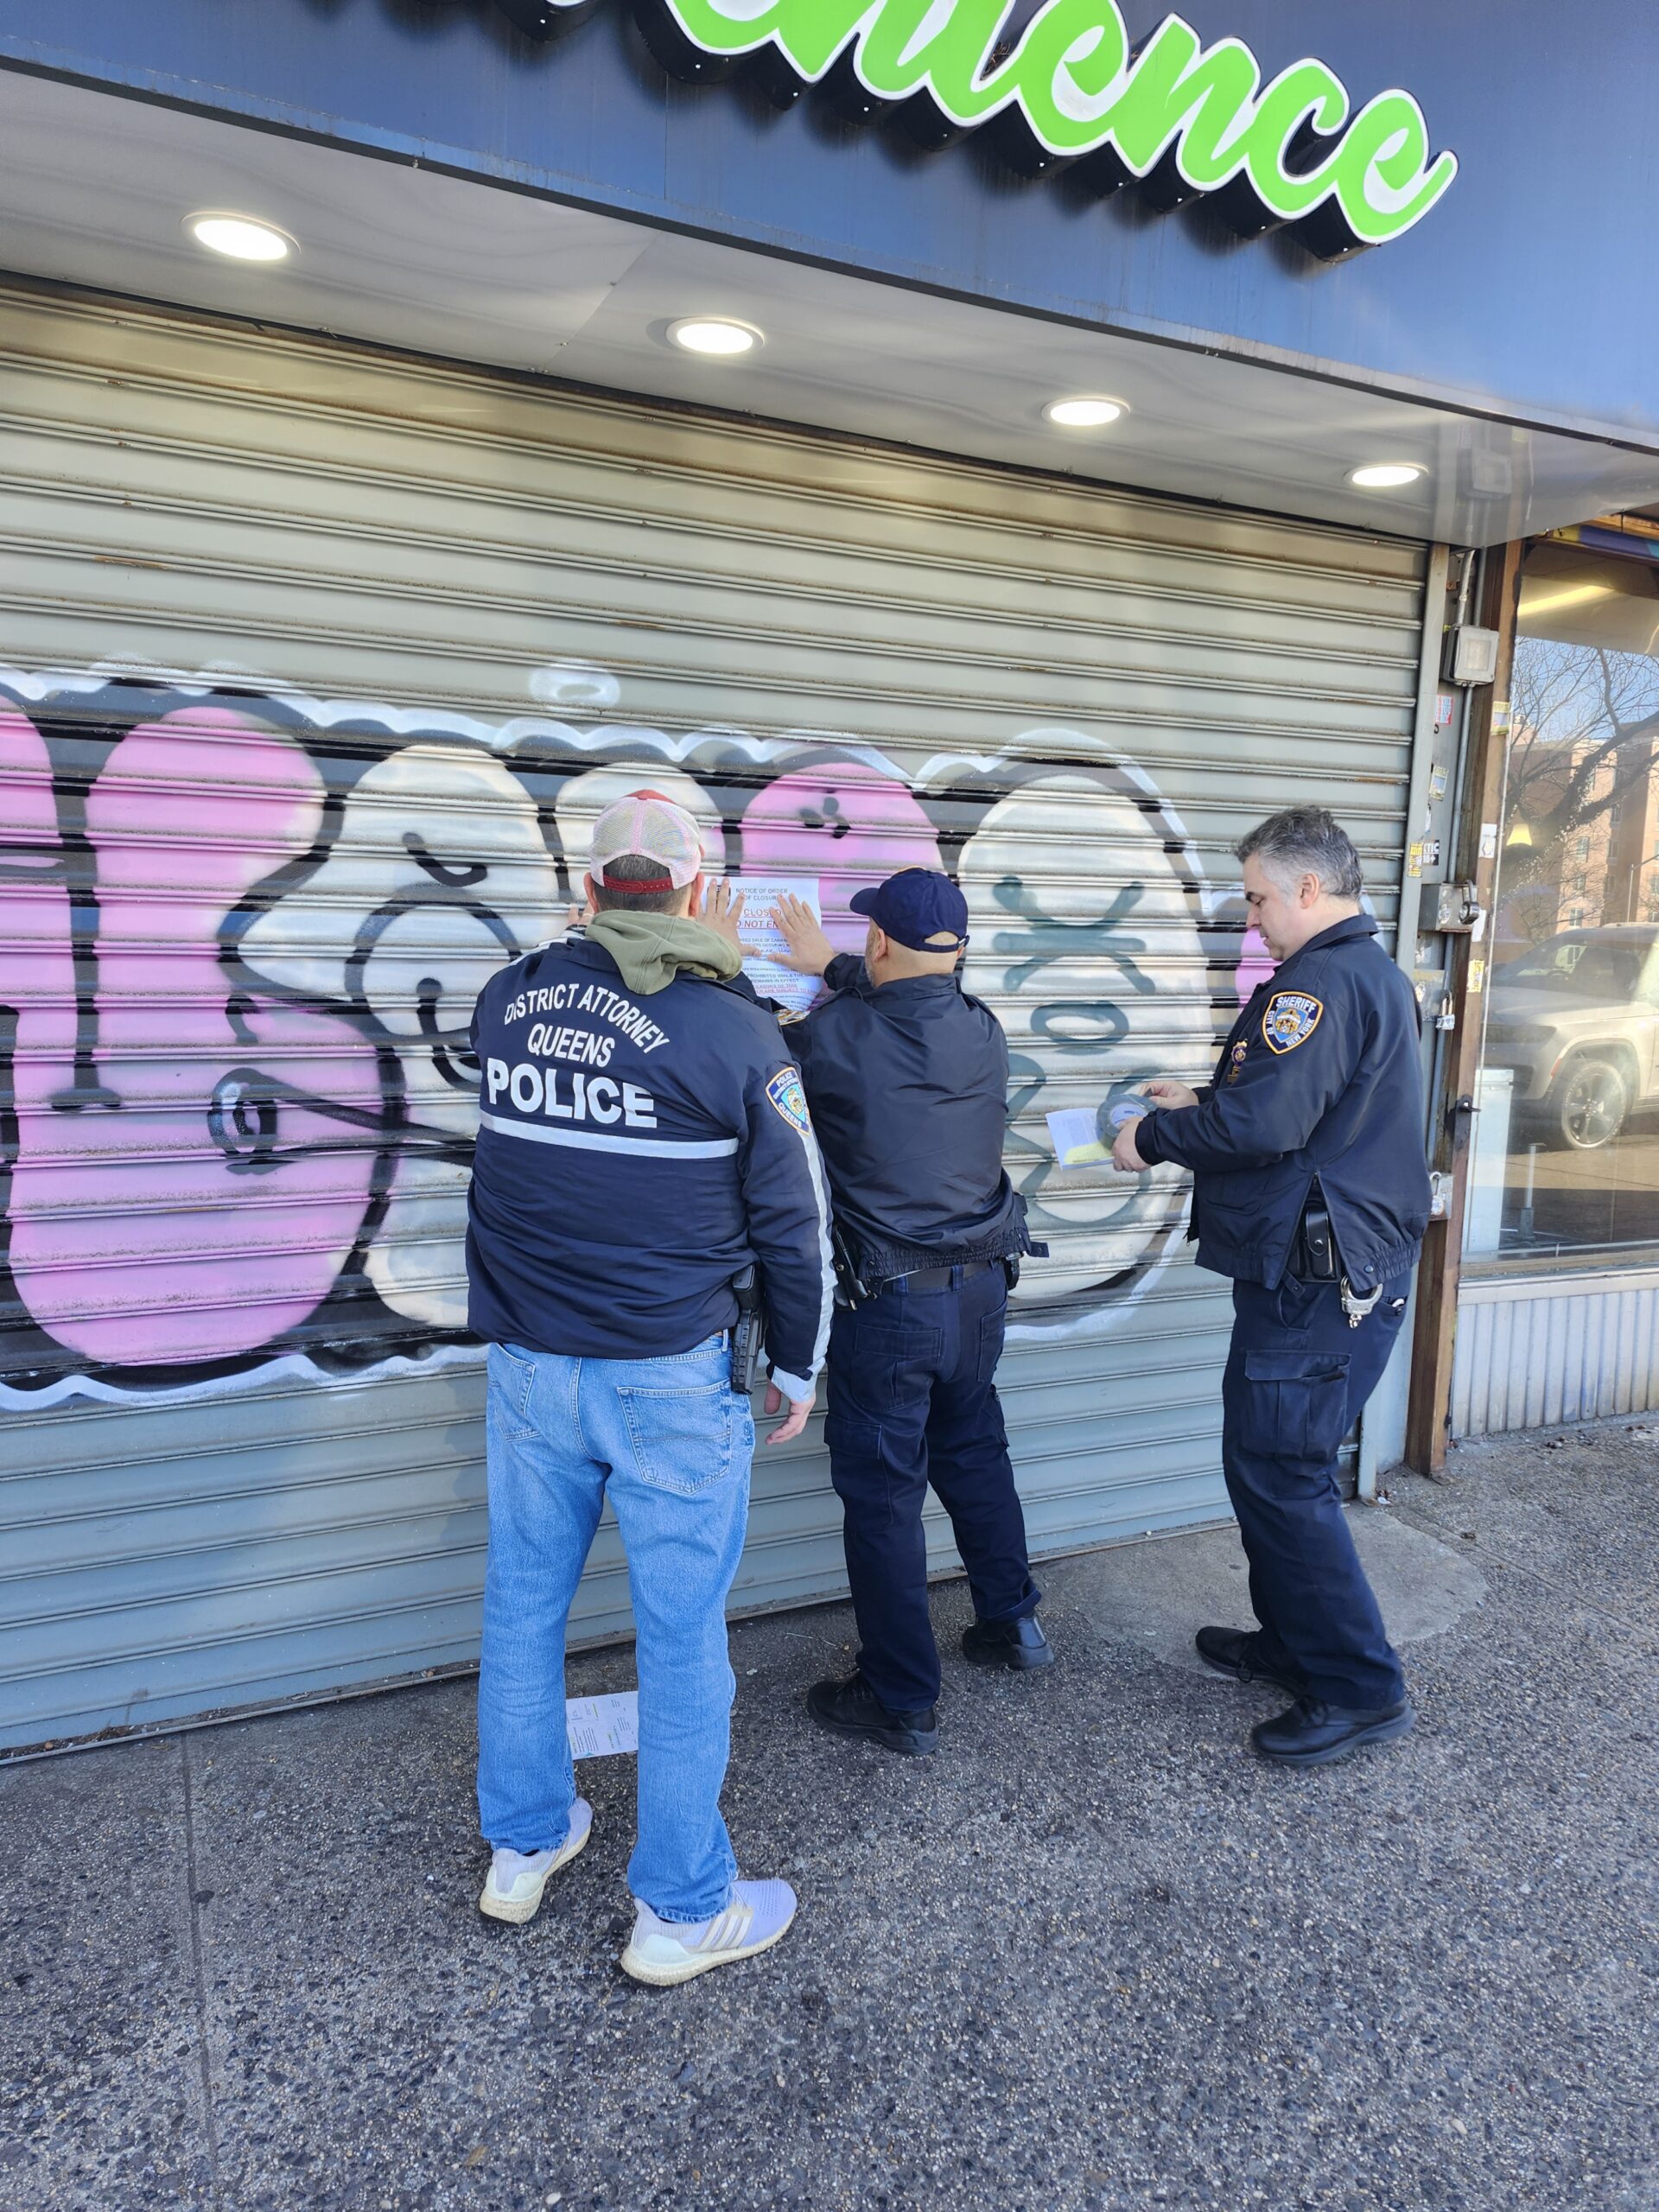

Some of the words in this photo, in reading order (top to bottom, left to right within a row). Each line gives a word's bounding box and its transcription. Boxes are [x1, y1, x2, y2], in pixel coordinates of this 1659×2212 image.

[743, 908, 782, 917] CLOSD
[1266, 1010, 1275, 1024] CITY
[1276, 996, 1316, 1012] SHERIFF
[505, 983, 579, 1026] DISTRICT
[579, 984, 670, 1054] ATTORNEY
[527, 1023, 615, 1068] QUEENS
[1285, 1033, 1302, 1047] NEW
[1300, 1018, 1315, 1035] YORK
[776, 1072, 792, 1086] POLICE
[487, 1058, 658, 1128] POLICE
[779, 1102, 802, 1128] QUEENS
